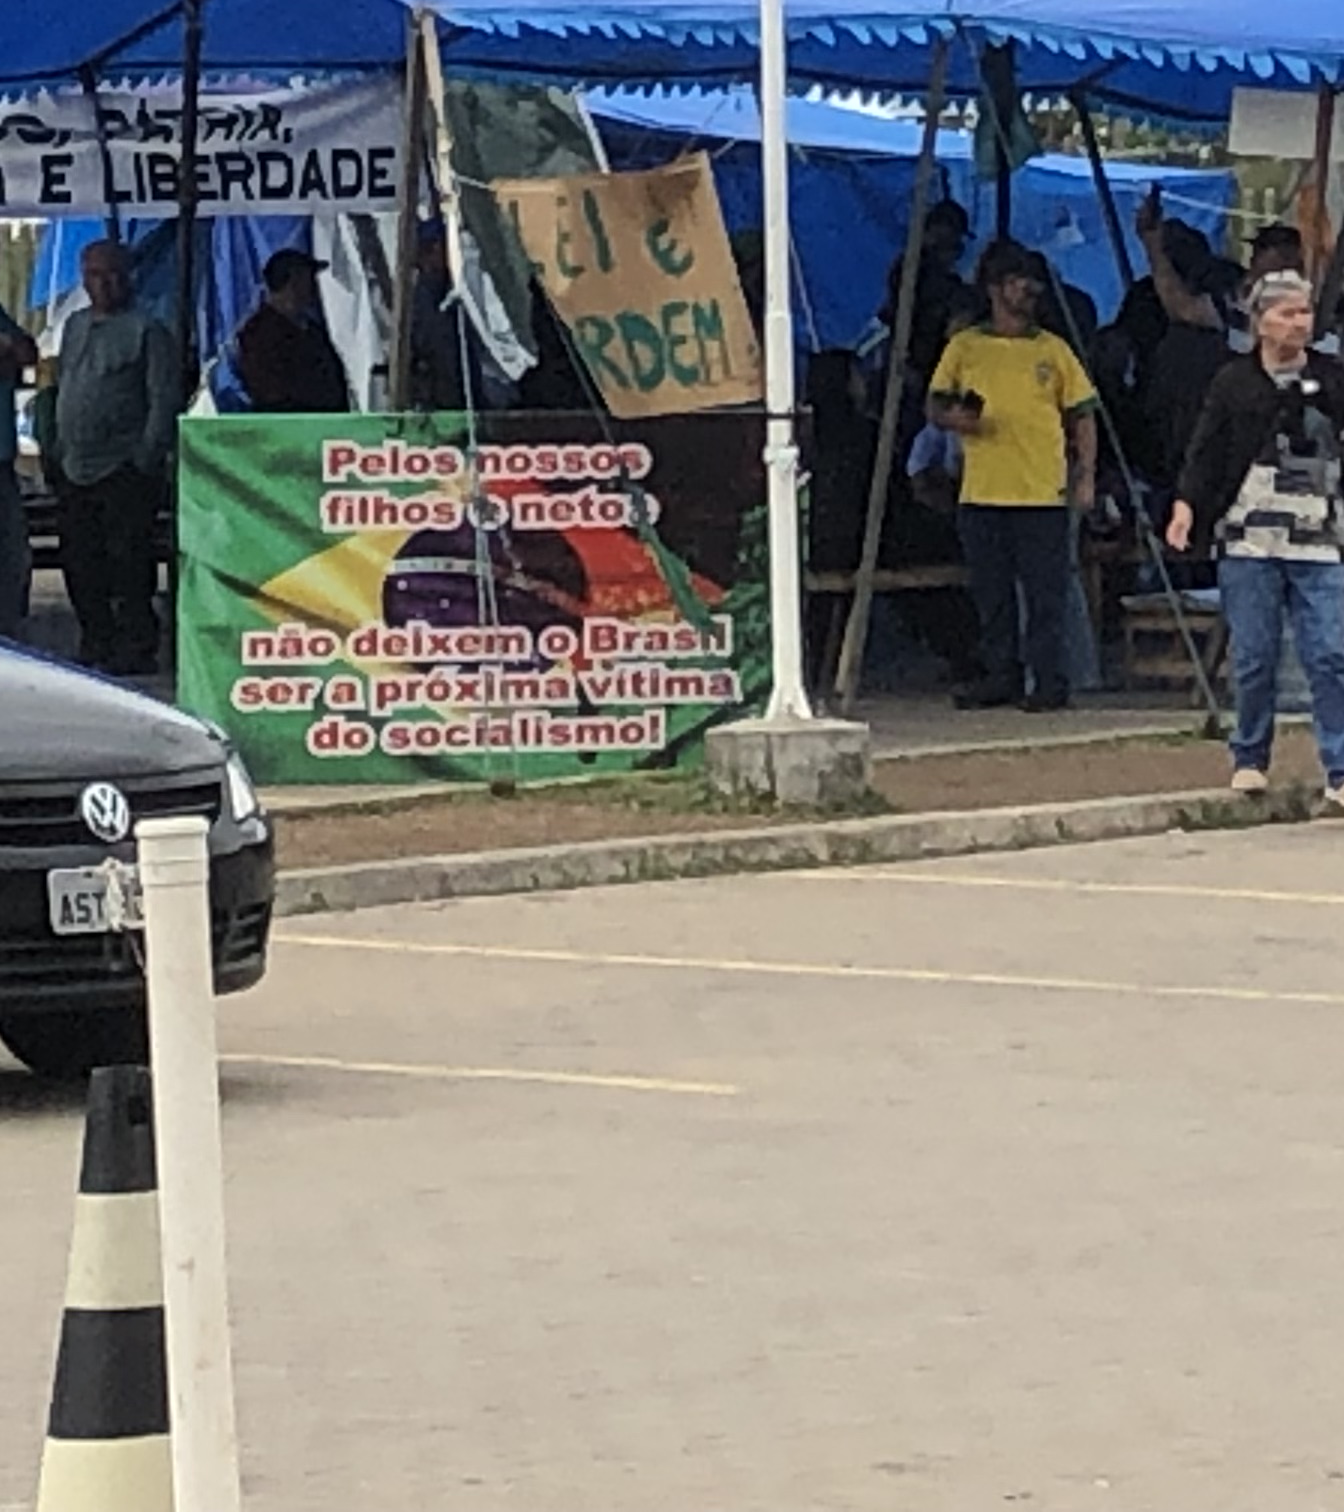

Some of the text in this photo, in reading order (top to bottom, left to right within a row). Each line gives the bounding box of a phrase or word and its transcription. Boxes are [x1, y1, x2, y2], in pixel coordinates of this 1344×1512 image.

[39, 152, 74, 204] E
[103, 146, 397, 204] LIBERDADE
[324, 442, 647, 479] Pelos nossos
[322, 494, 459, 528] filhos
[516, 493, 652, 526] neto
[244, 625, 339, 661] não
[349, 623, 528, 658] deixem
[542, 629, 573, 656] o
[235, 665, 737, 712] ser a próxima vítima
[310, 712, 663, 753] do socialismo!
